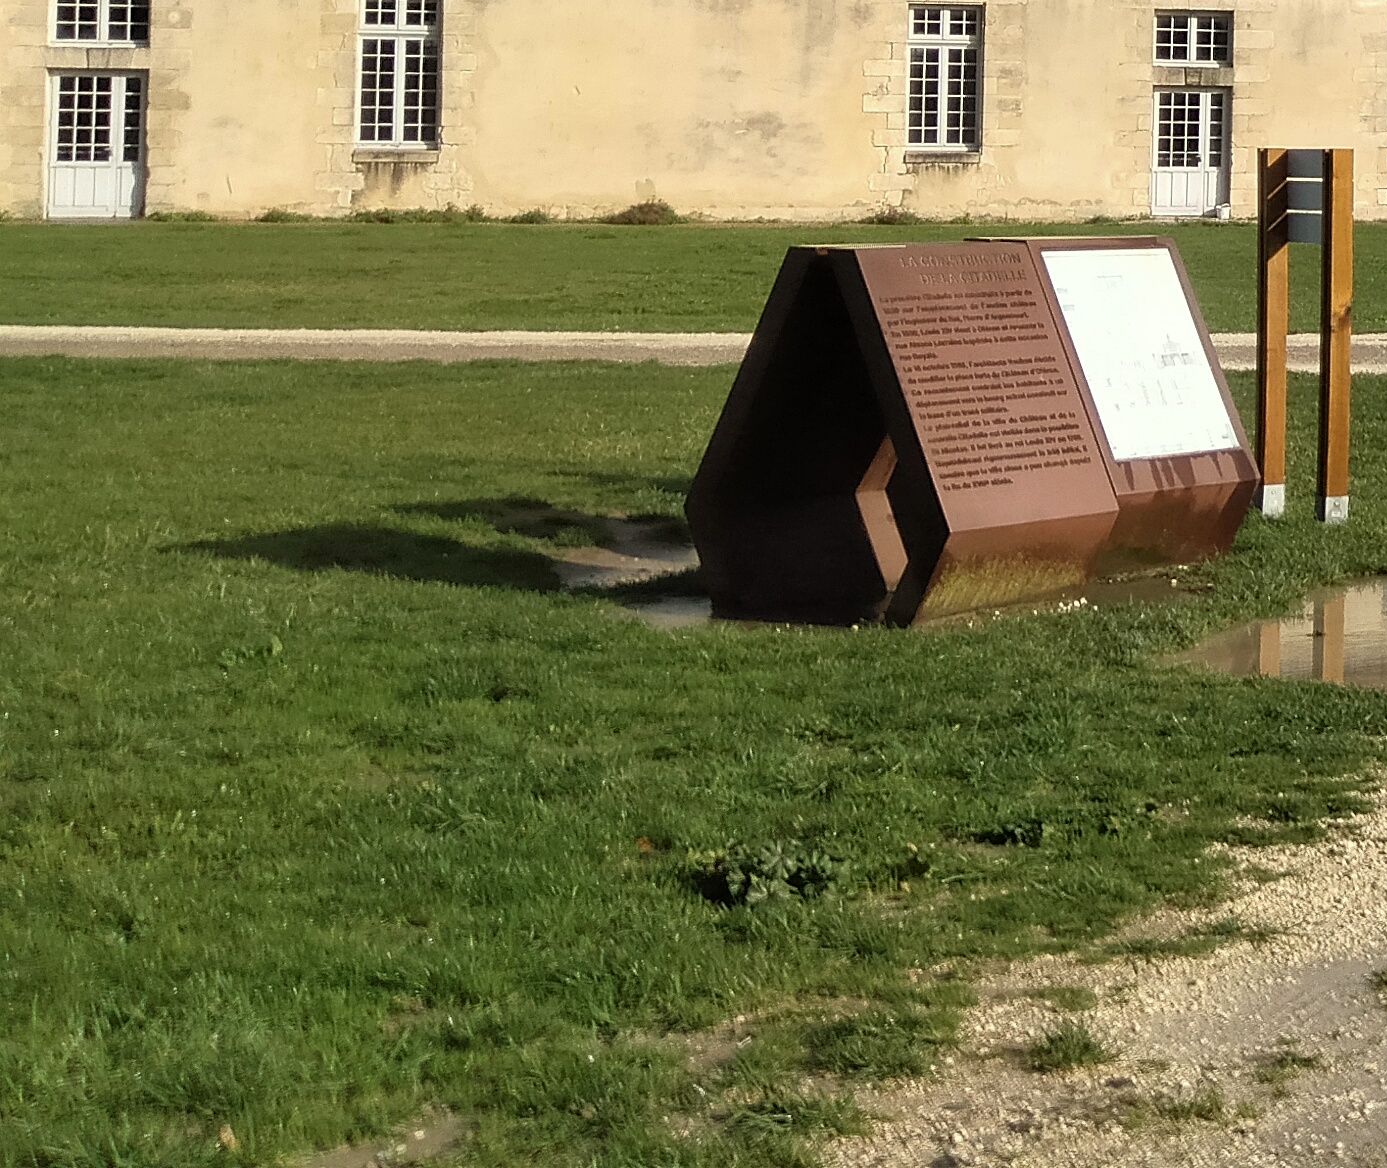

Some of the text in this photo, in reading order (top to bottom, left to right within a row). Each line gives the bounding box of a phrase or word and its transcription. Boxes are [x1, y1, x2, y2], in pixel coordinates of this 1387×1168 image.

[899, 257, 918, 268] LA
[919, 274, 937, 285] DE
[939, 273, 958, 284] LA
